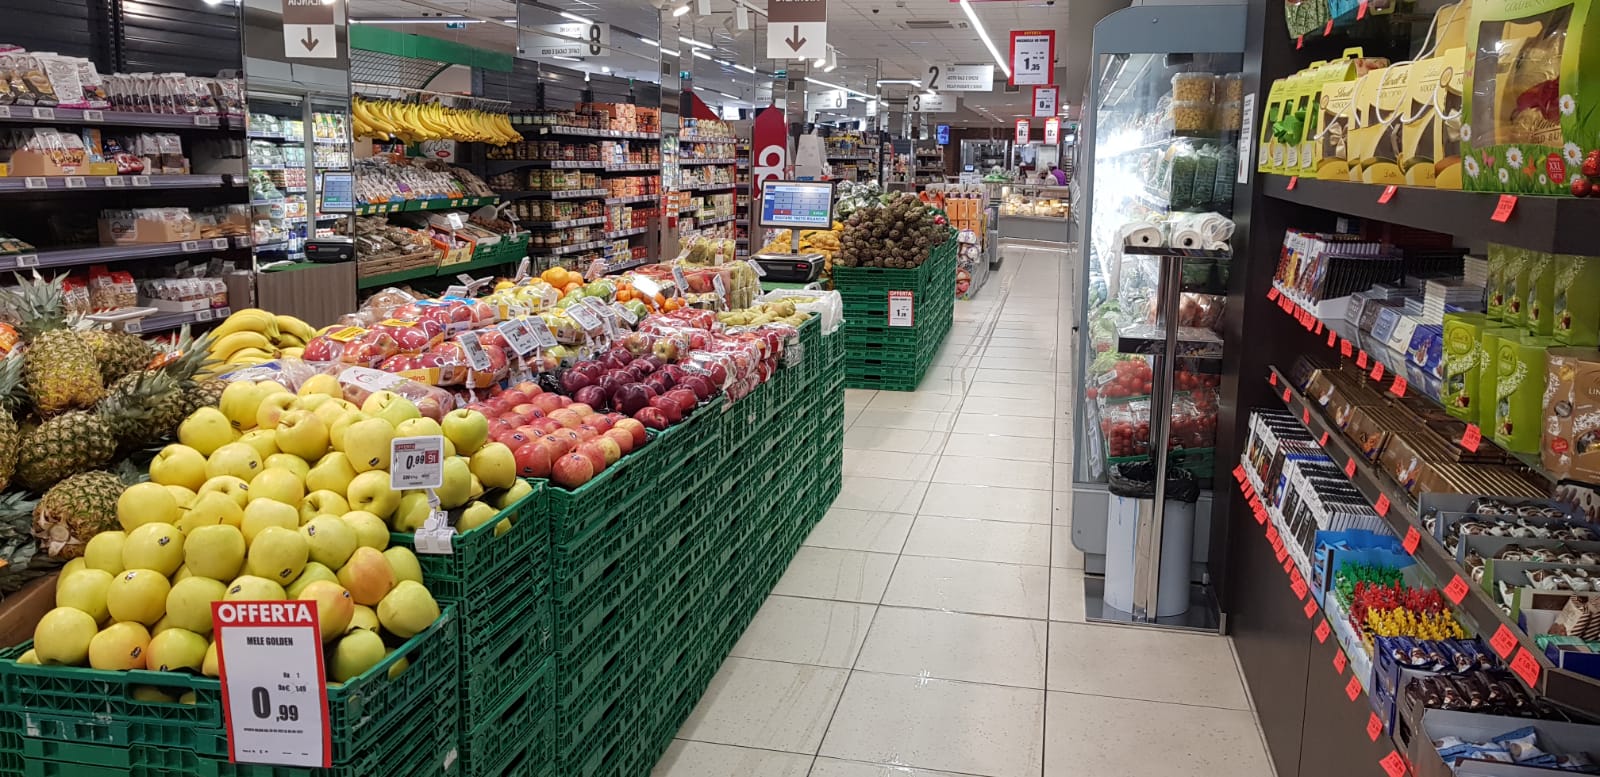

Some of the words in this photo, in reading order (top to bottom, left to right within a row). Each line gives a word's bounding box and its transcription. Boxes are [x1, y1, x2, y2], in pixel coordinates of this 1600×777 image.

[928, 66, 939, 89] 2
[912, 95, 921, 111] 3
[1549, 161, 1563, 171] XXL
[217, 603, 313, 623] OFFERTA
[246, 636, 265, 646] MELE
[265, 637, 294, 646] GOLDEN
